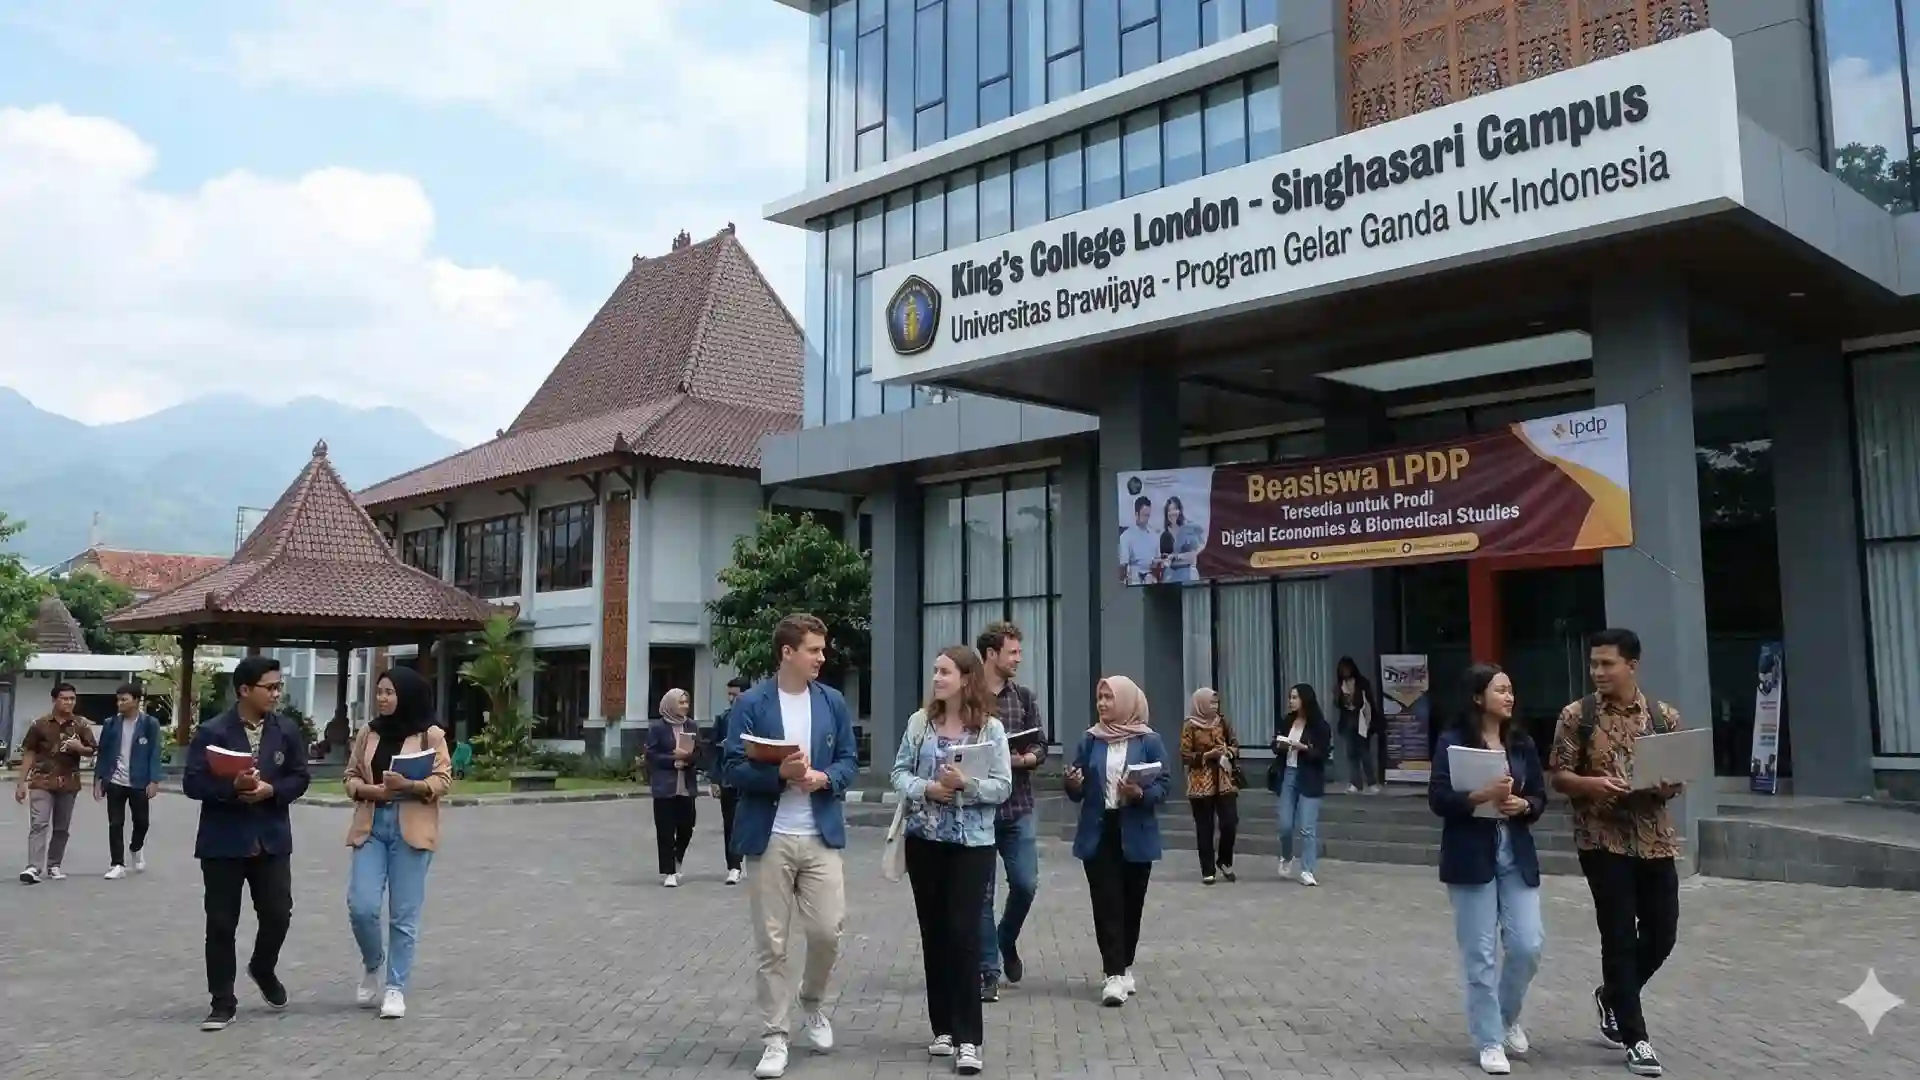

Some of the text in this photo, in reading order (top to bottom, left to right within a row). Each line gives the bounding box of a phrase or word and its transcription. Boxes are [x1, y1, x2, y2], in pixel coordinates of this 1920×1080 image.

[952, 84, 1649, 298] King's College London - Singhasari Campus
[951, 145, 1670, 343] Universitas Brawijaya - Program Gelar Ganda UK-Indonesia
[1569, 416, 1607, 438] lpdp
[1247, 448, 1470, 503] Beasiswa LPDP
[1221, 503, 1520, 548] Digital Economies & Biomedical Studies
[1282, 489, 1434, 521] Tersedia untuk Prodi
